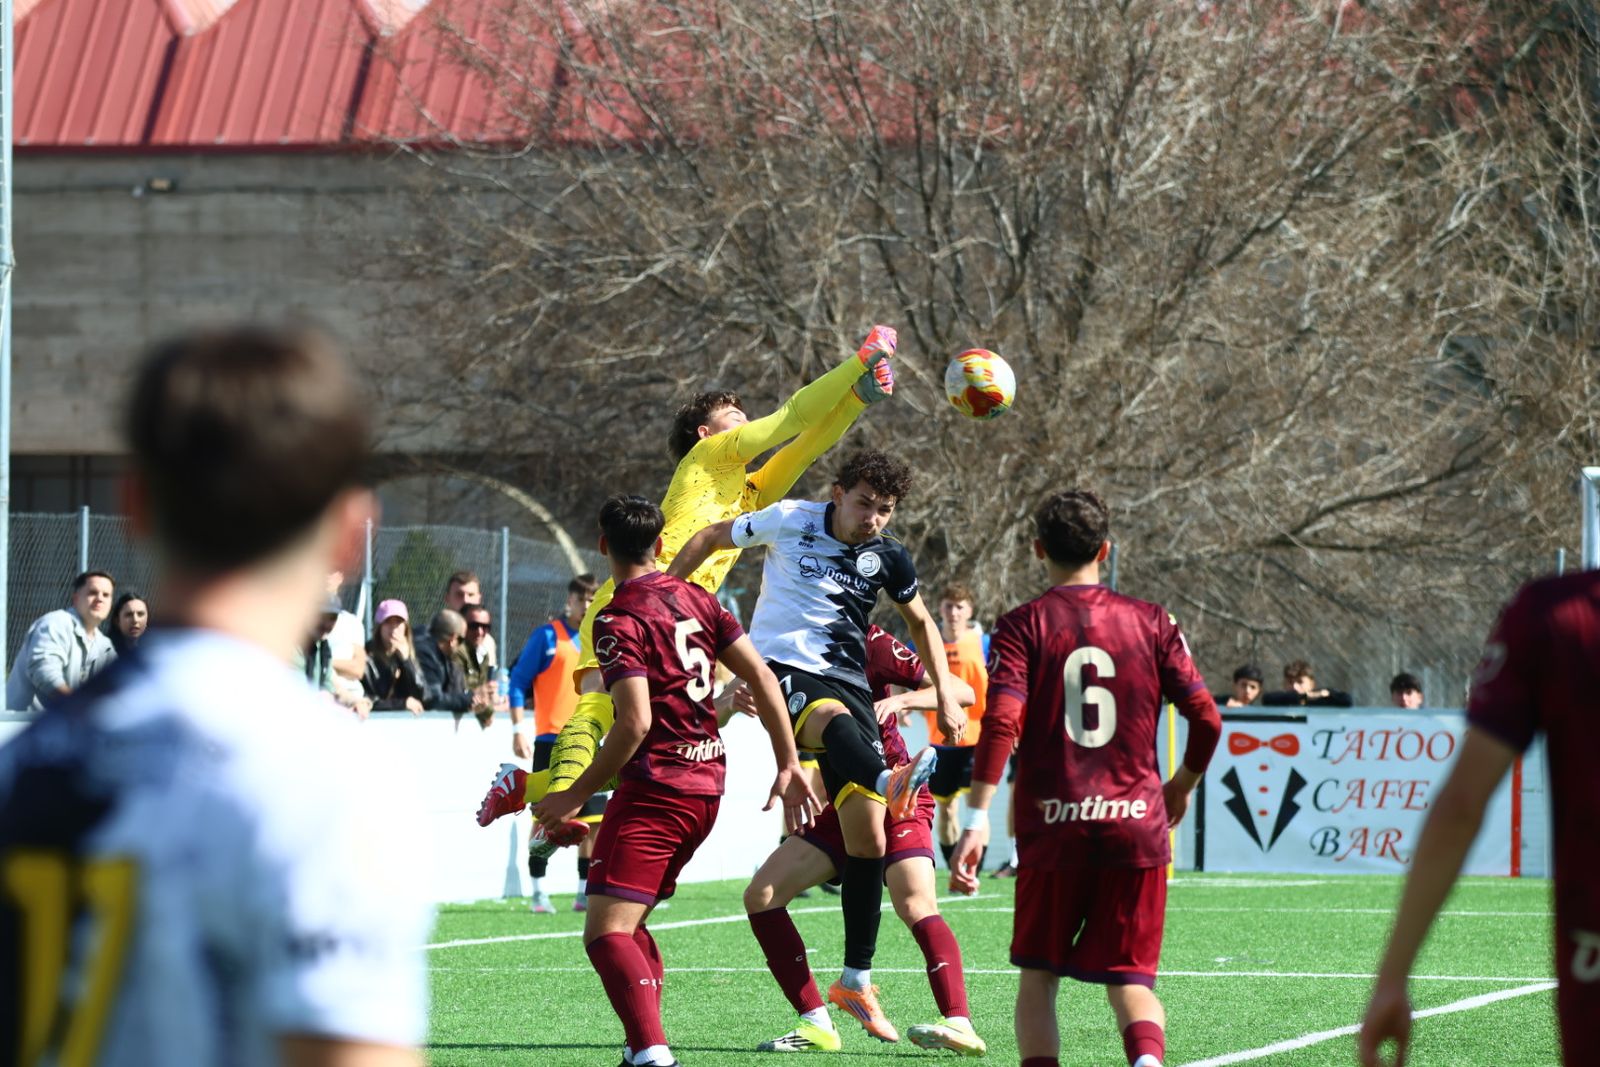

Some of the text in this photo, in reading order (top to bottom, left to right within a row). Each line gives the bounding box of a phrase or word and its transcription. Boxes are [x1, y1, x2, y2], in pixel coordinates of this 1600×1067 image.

[824, 566, 851, 584] Don
[675, 618, 711, 702] 5
[1064, 646, 1116, 748] 6
[1312, 726, 1455, 765] TATOO
[1042, 795, 1147, 824] Ontime
[1311, 778, 1431, 814] CAFE
[1309, 826, 1411, 864] BAR
